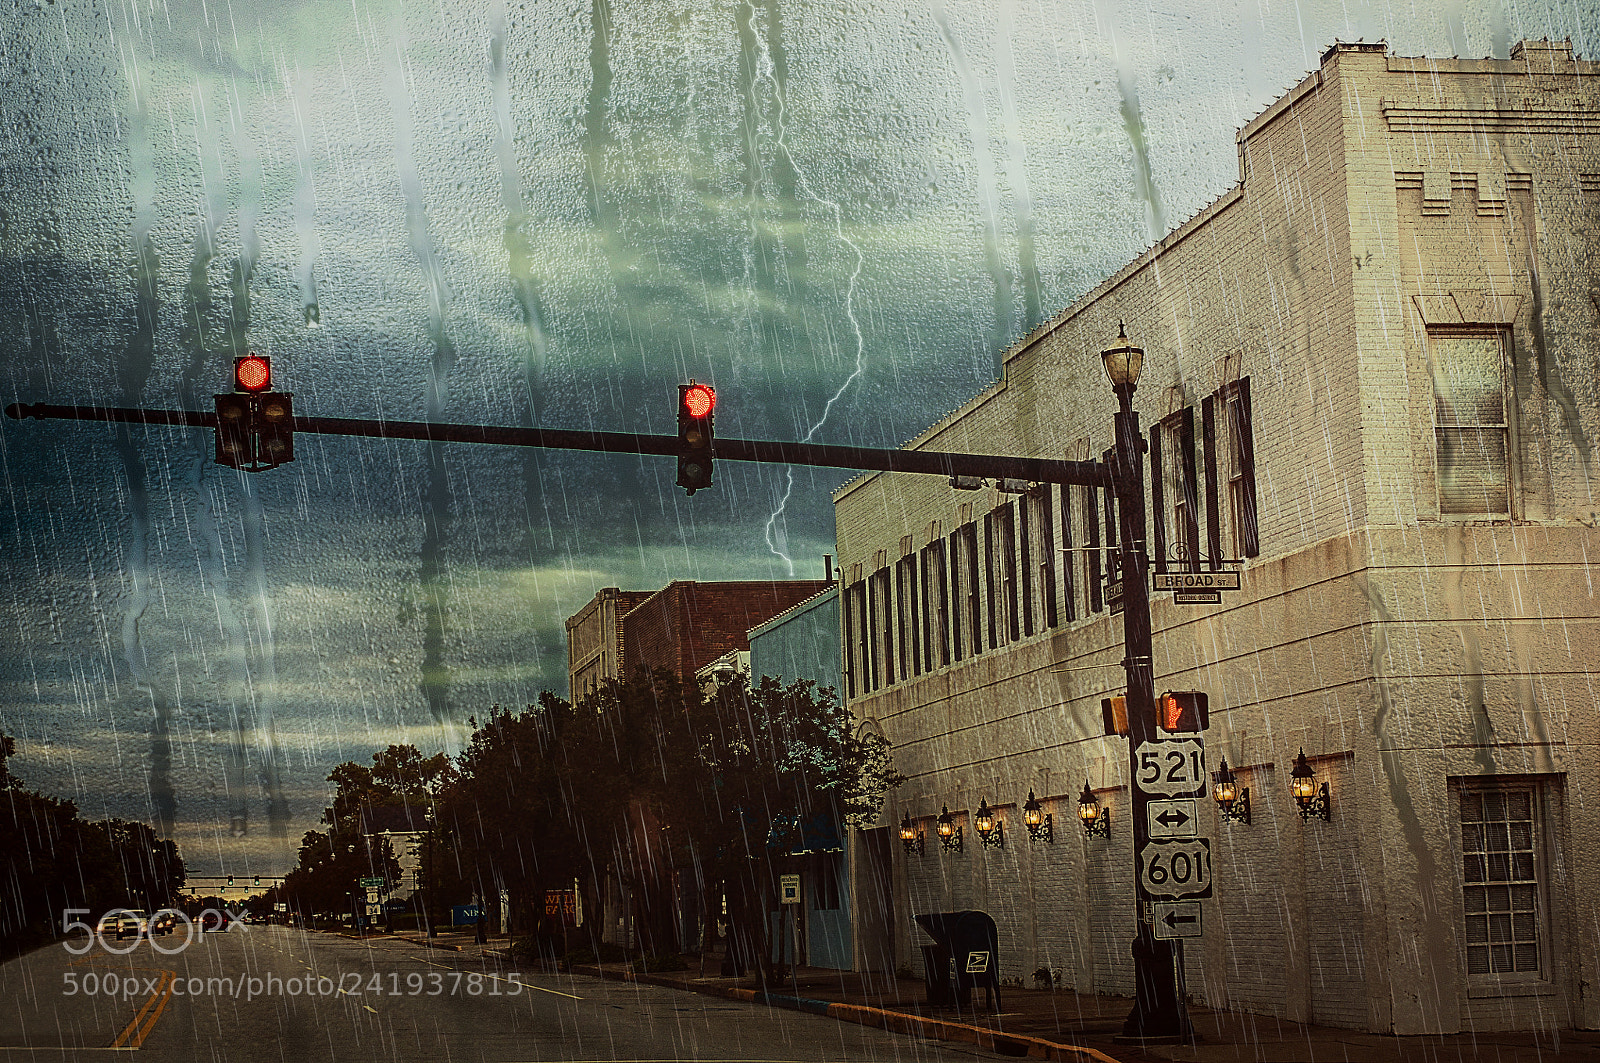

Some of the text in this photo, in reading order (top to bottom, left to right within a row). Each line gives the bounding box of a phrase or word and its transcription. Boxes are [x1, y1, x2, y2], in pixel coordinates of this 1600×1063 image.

[1165, 575, 1214, 587] BROAD
[1141, 750, 1200, 784] 521
[1149, 851, 1204, 885] 601
